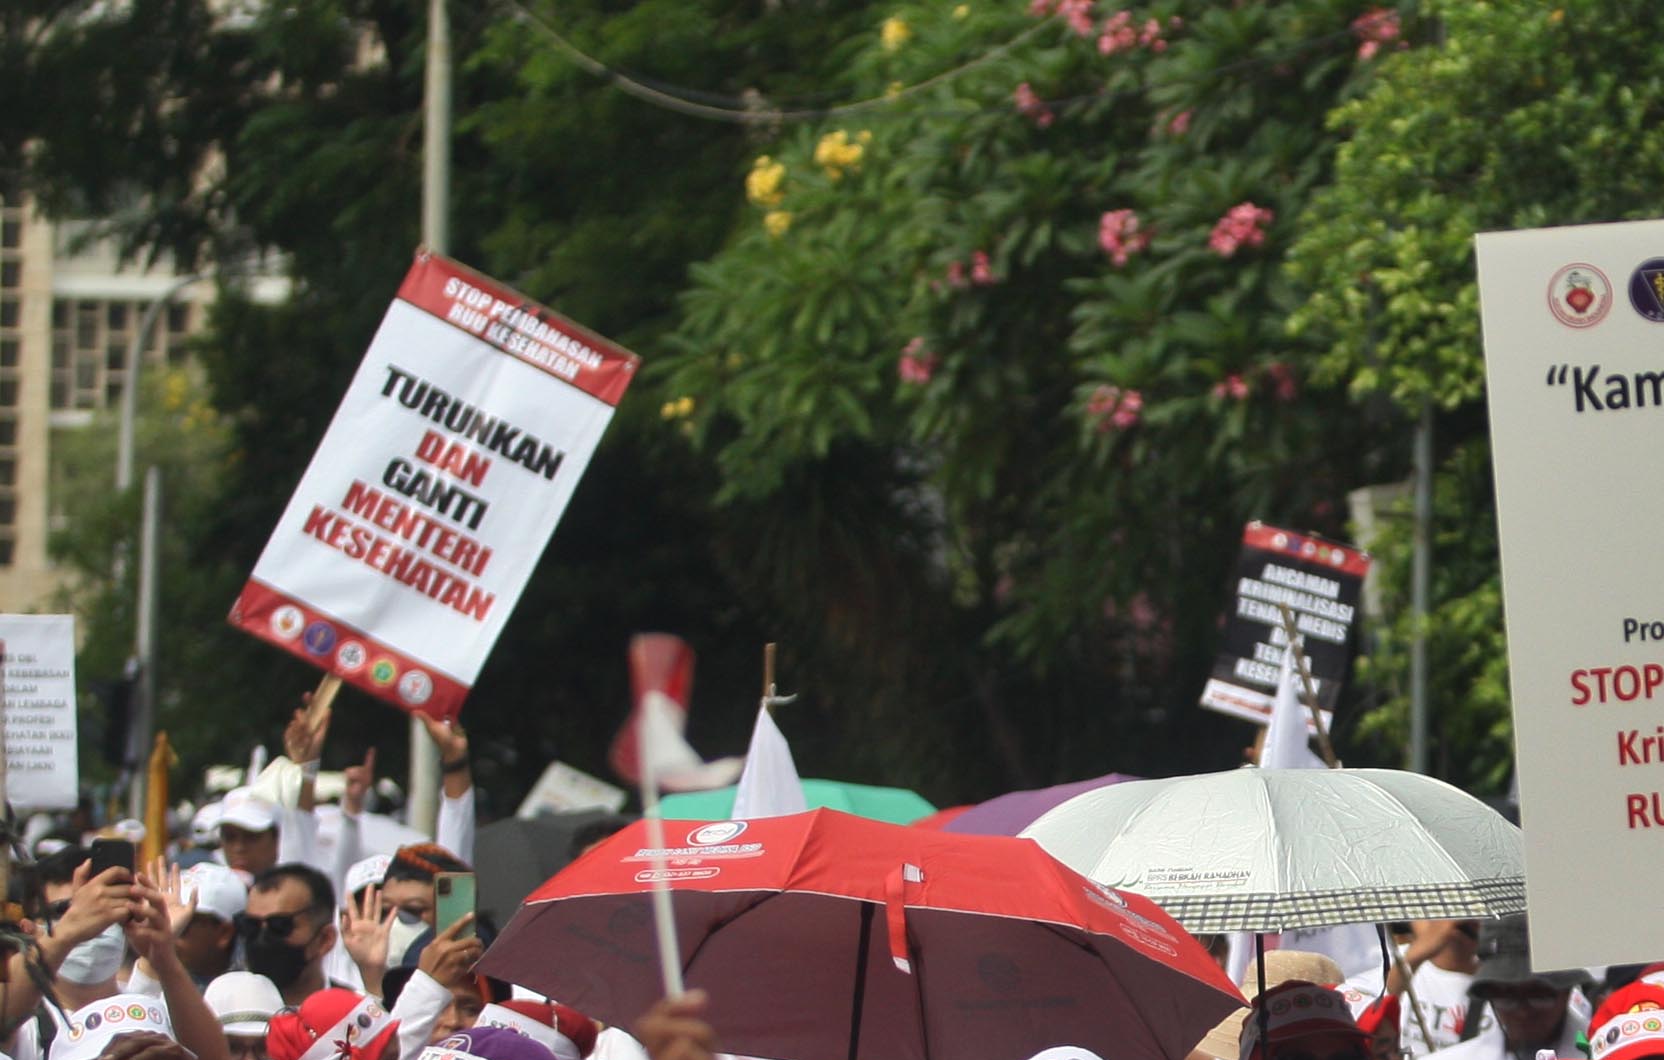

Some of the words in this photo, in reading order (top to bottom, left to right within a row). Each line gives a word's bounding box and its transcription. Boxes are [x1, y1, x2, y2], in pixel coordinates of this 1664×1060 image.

[443, 277, 493, 310] STOP
[485, 321, 580, 380] KESEHATAN
[381, 363, 565, 481] TURUNKAN
[415, 428, 491, 488] DAN
[382, 457, 489, 530] GANTI
[341, 479, 494, 577] MENTERI
[302, 505, 496, 622] KESEHATAN
[1570, 663, 1664, 706] STOP
